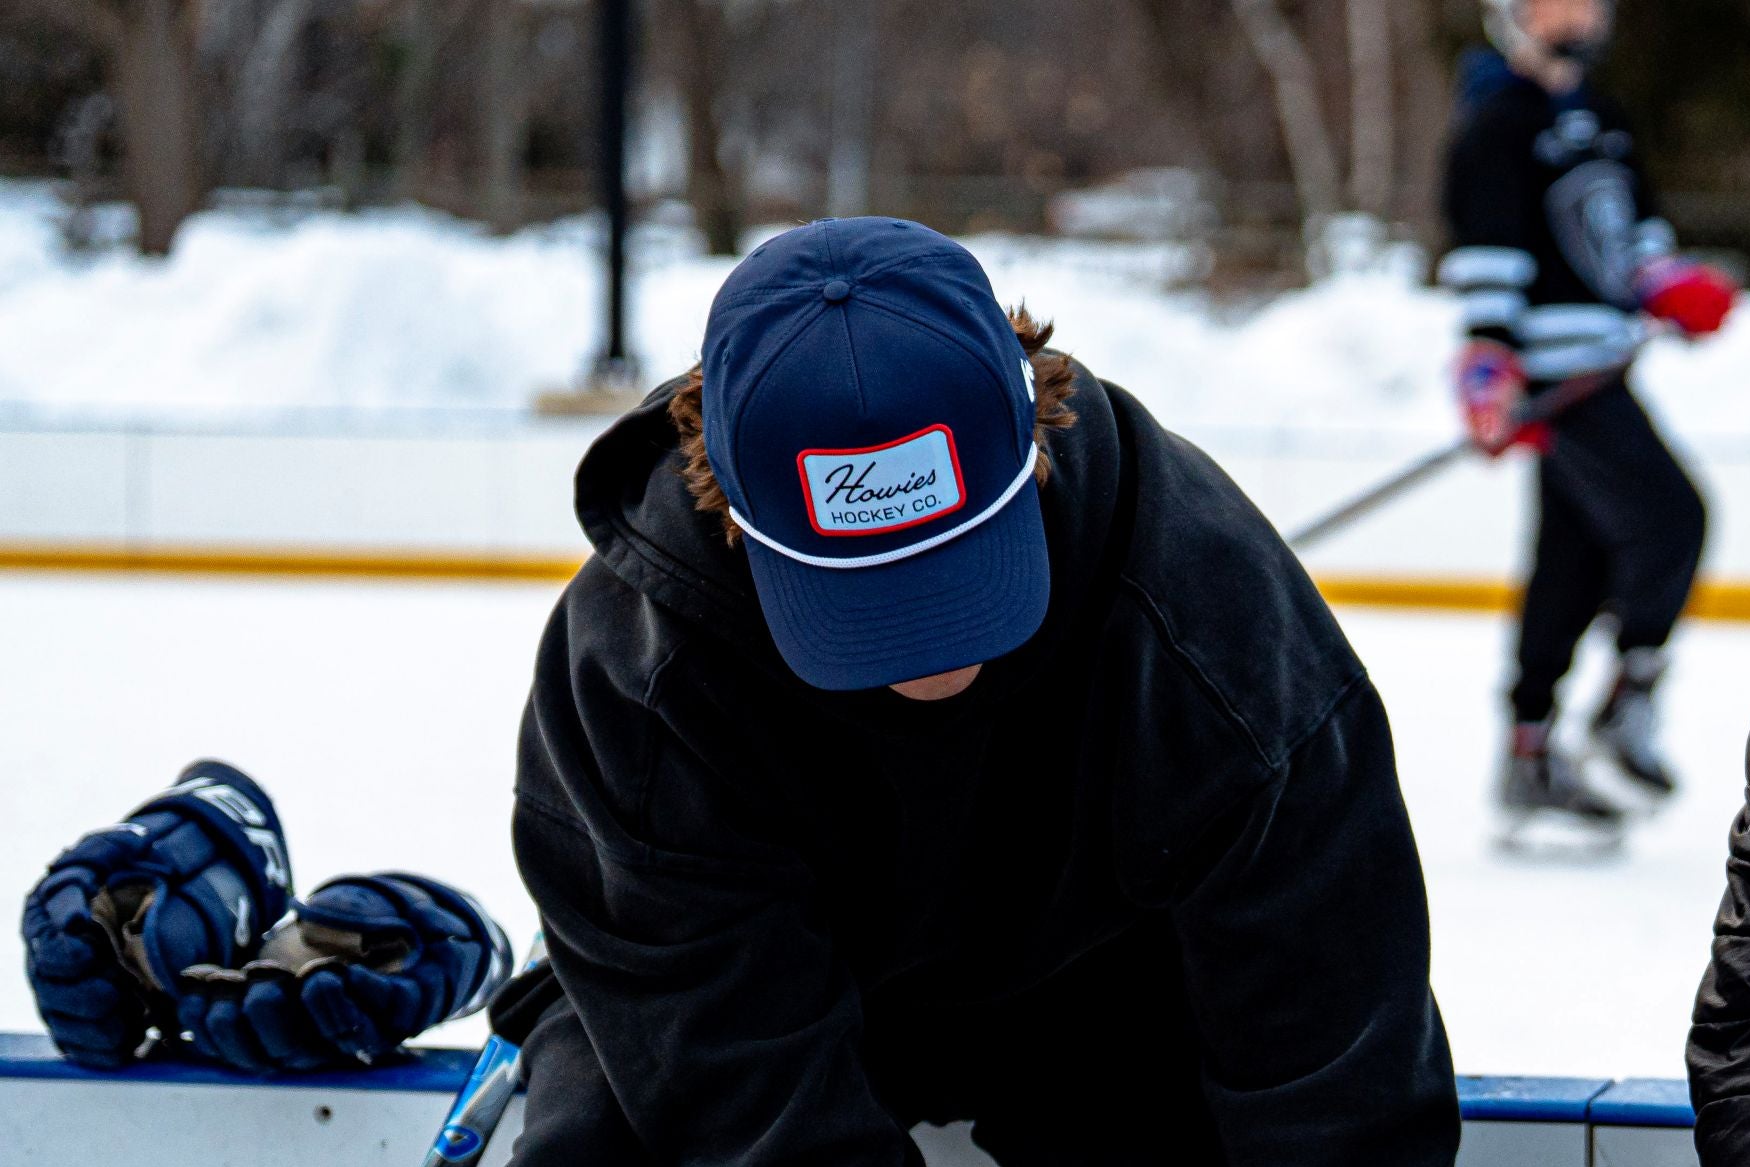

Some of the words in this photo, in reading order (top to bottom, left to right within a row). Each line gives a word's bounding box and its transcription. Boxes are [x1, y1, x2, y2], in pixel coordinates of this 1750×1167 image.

[825, 461, 937, 504] Howies
[831, 504, 905, 524] HOCKEY
[912, 494, 942, 513] CO.
